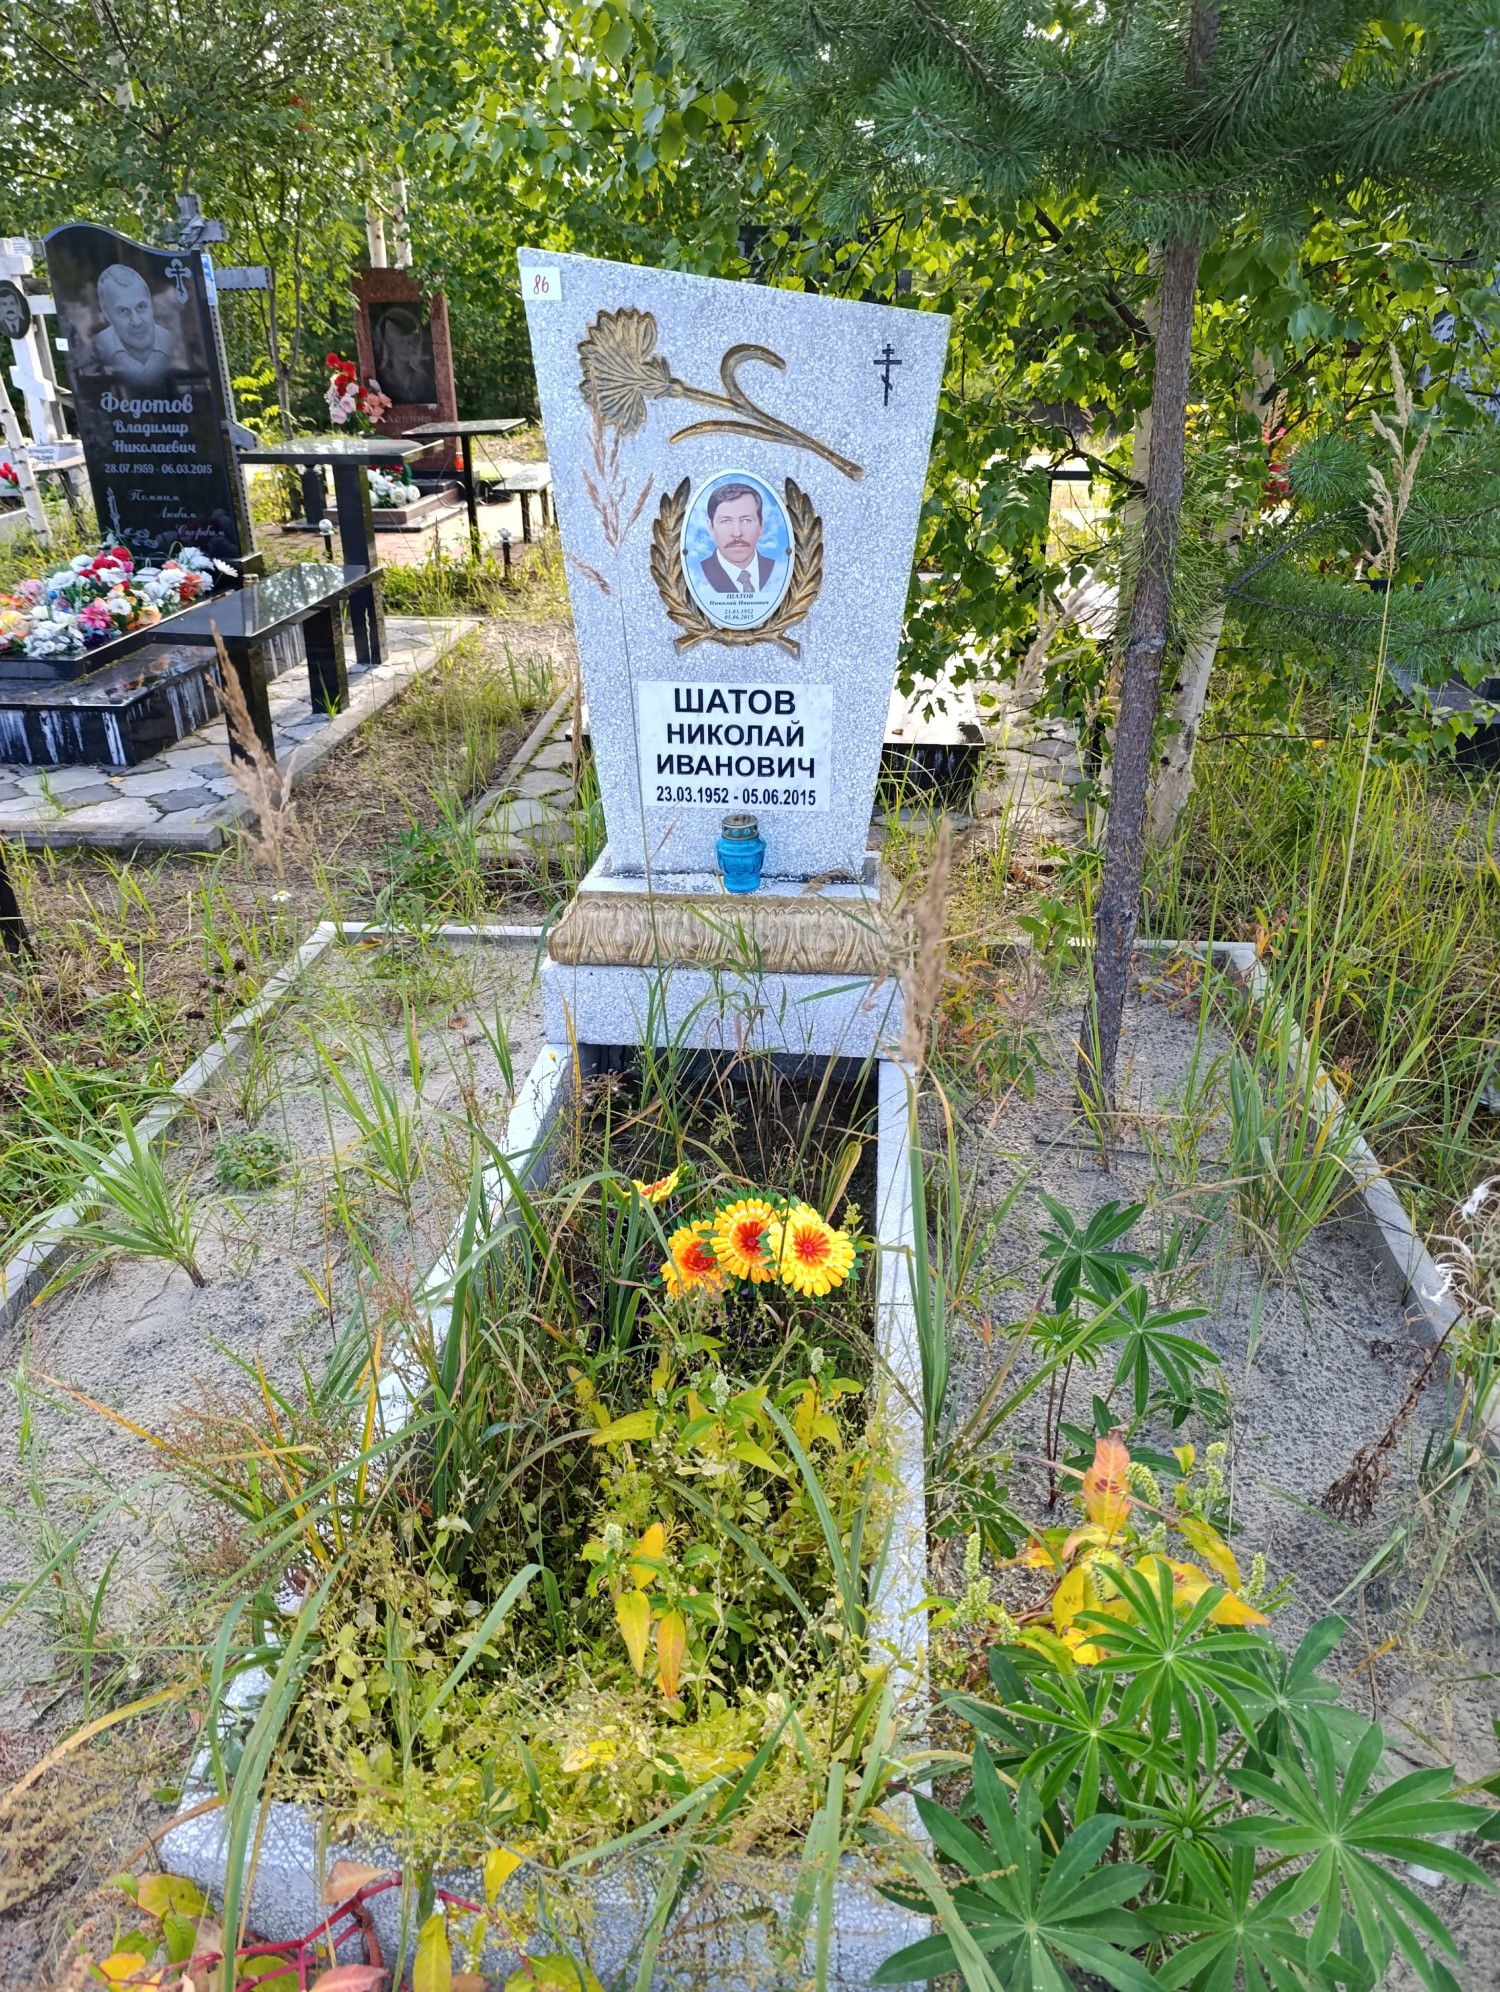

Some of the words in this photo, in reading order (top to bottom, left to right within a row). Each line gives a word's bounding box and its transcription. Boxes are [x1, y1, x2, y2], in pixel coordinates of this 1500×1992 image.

[533, 274, 549, 294] 86
[100, 392, 193, 419] Федотов
[113, 420, 189, 437] Владимир
[112, 440, 197, 453] Николаевич
[104, 463, 155, 474] 28.07.1959
[161, 463, 213, 475] 06.03.2015
[674, 688, 796, 715] ШАТОВ
[667, 720, 804, 747] НИКОЛАЙ
[657, 754, 815, 778] ИВАНОВИЧ
[656, 786, 729, 804] 23.03.1952
[742, 788, 816, 806] 05.06.2015
